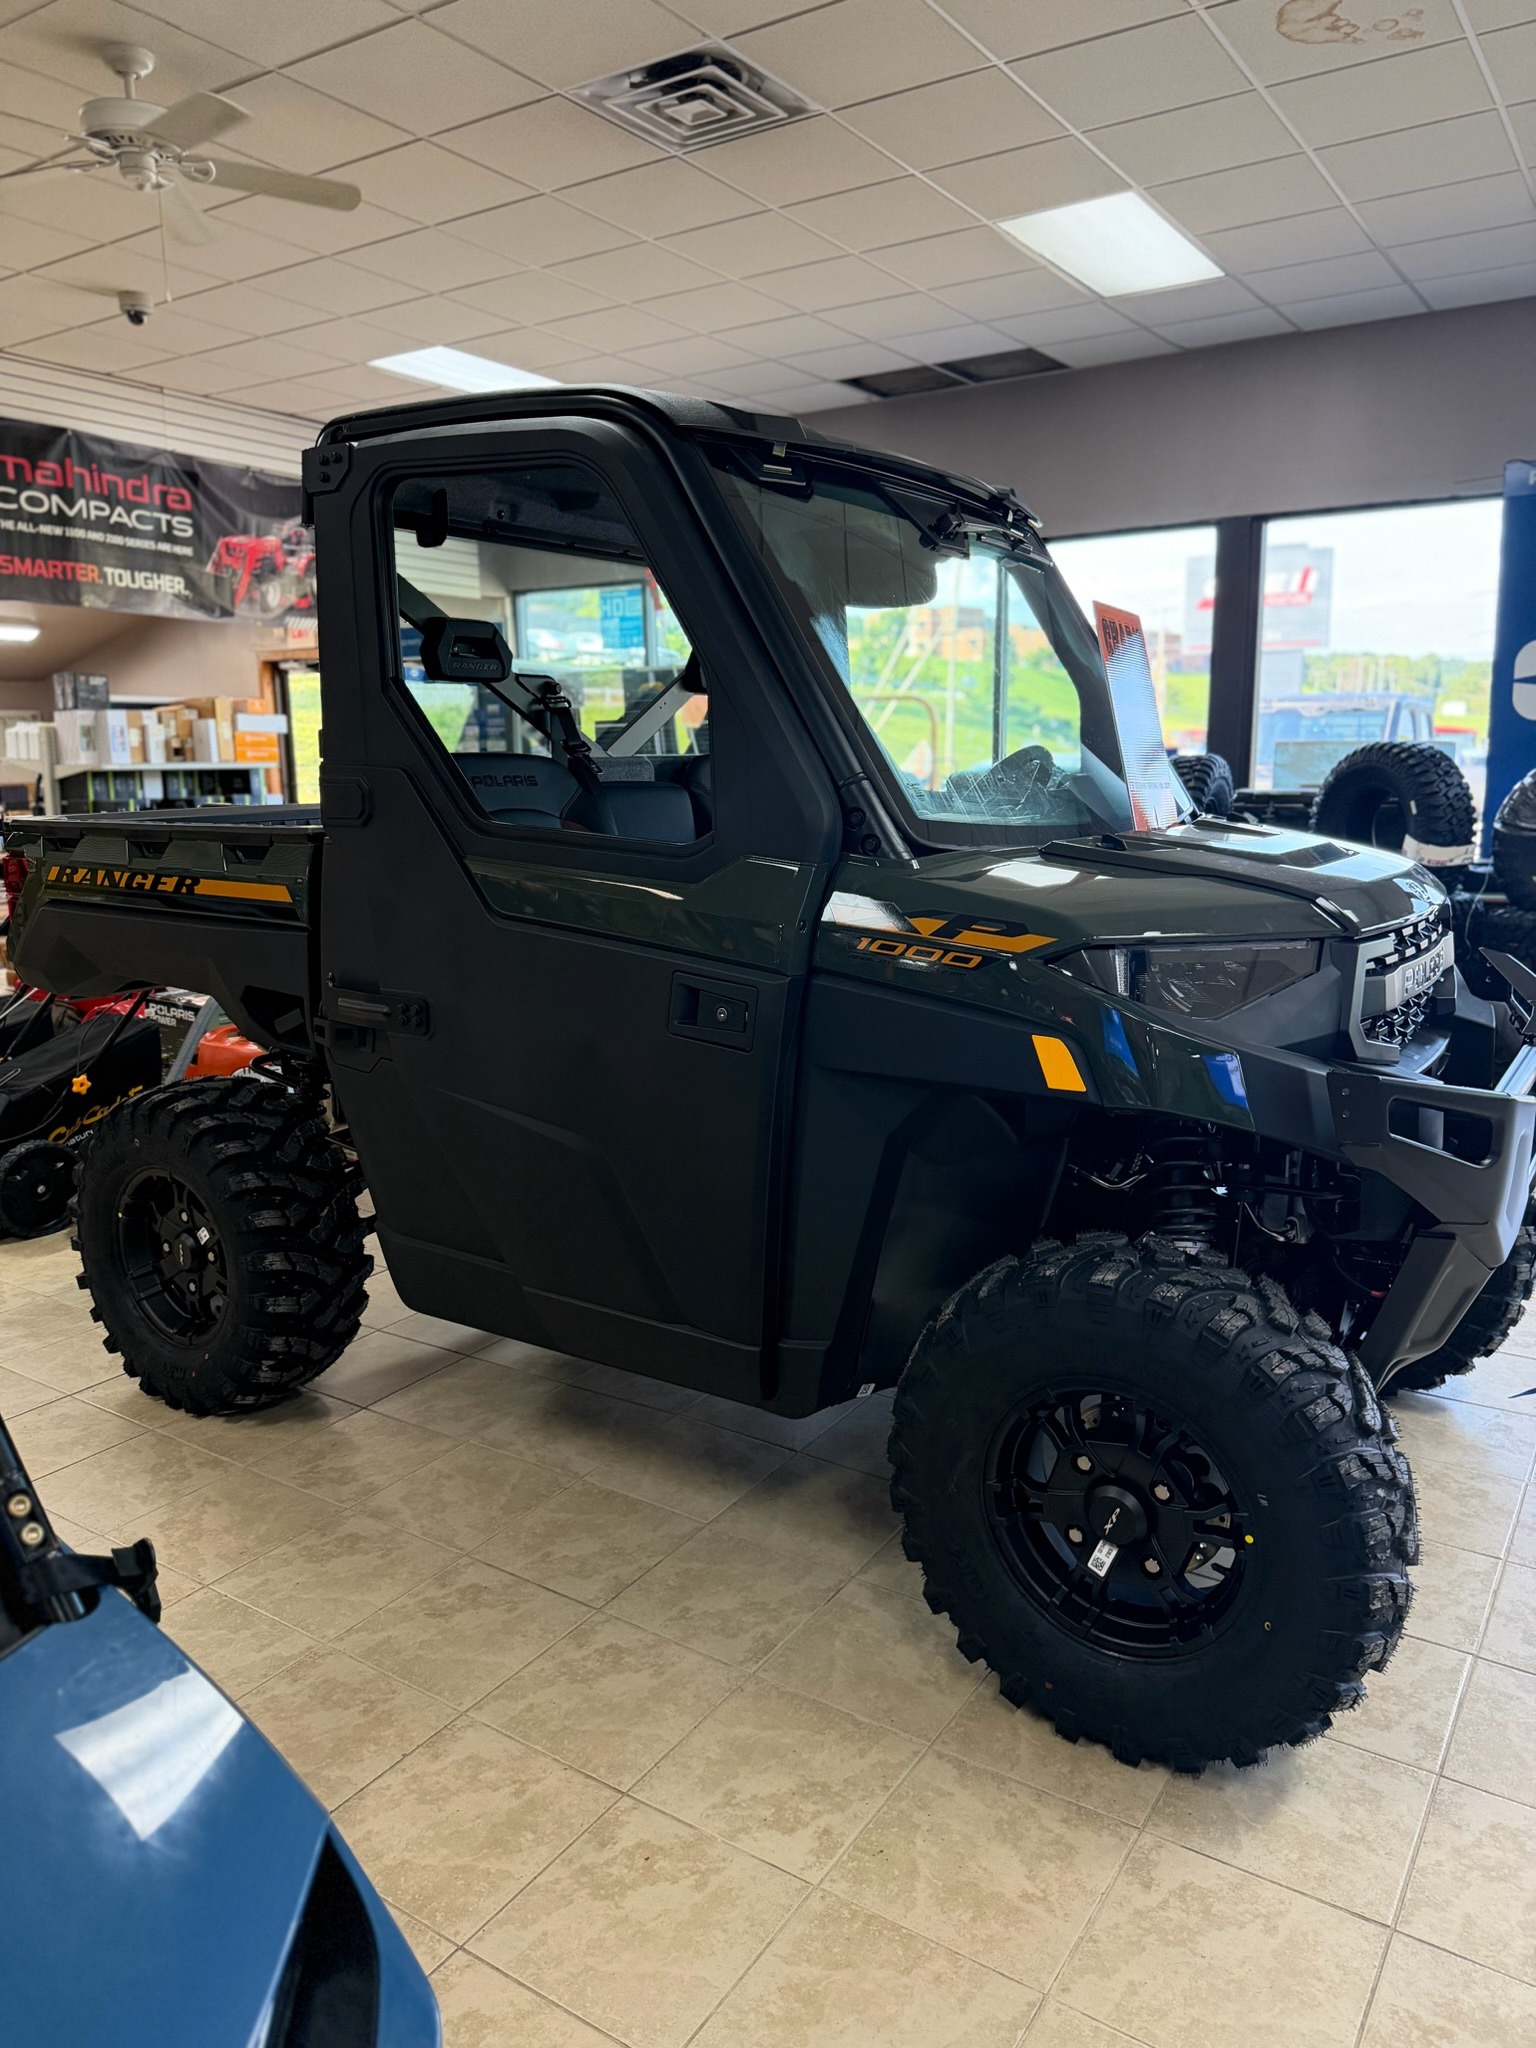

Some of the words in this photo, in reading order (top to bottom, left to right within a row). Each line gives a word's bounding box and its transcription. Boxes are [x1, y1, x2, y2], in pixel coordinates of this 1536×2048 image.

[0, 454, 193, 512] mahindra
[0, 485, 194, 538] COMPACTS
[0, 554, 104, 584] SMARTER.
[103, 566, 189, 595] TOUGHER.
[452, 662, 498, 671] RANGER
[471, 775, 539, 788] POLARIS
[54, 865, 201, 895] RANGER
[856, 936, 983, 969] 1000
[149, 1003, 196, 1022] POLARIS
